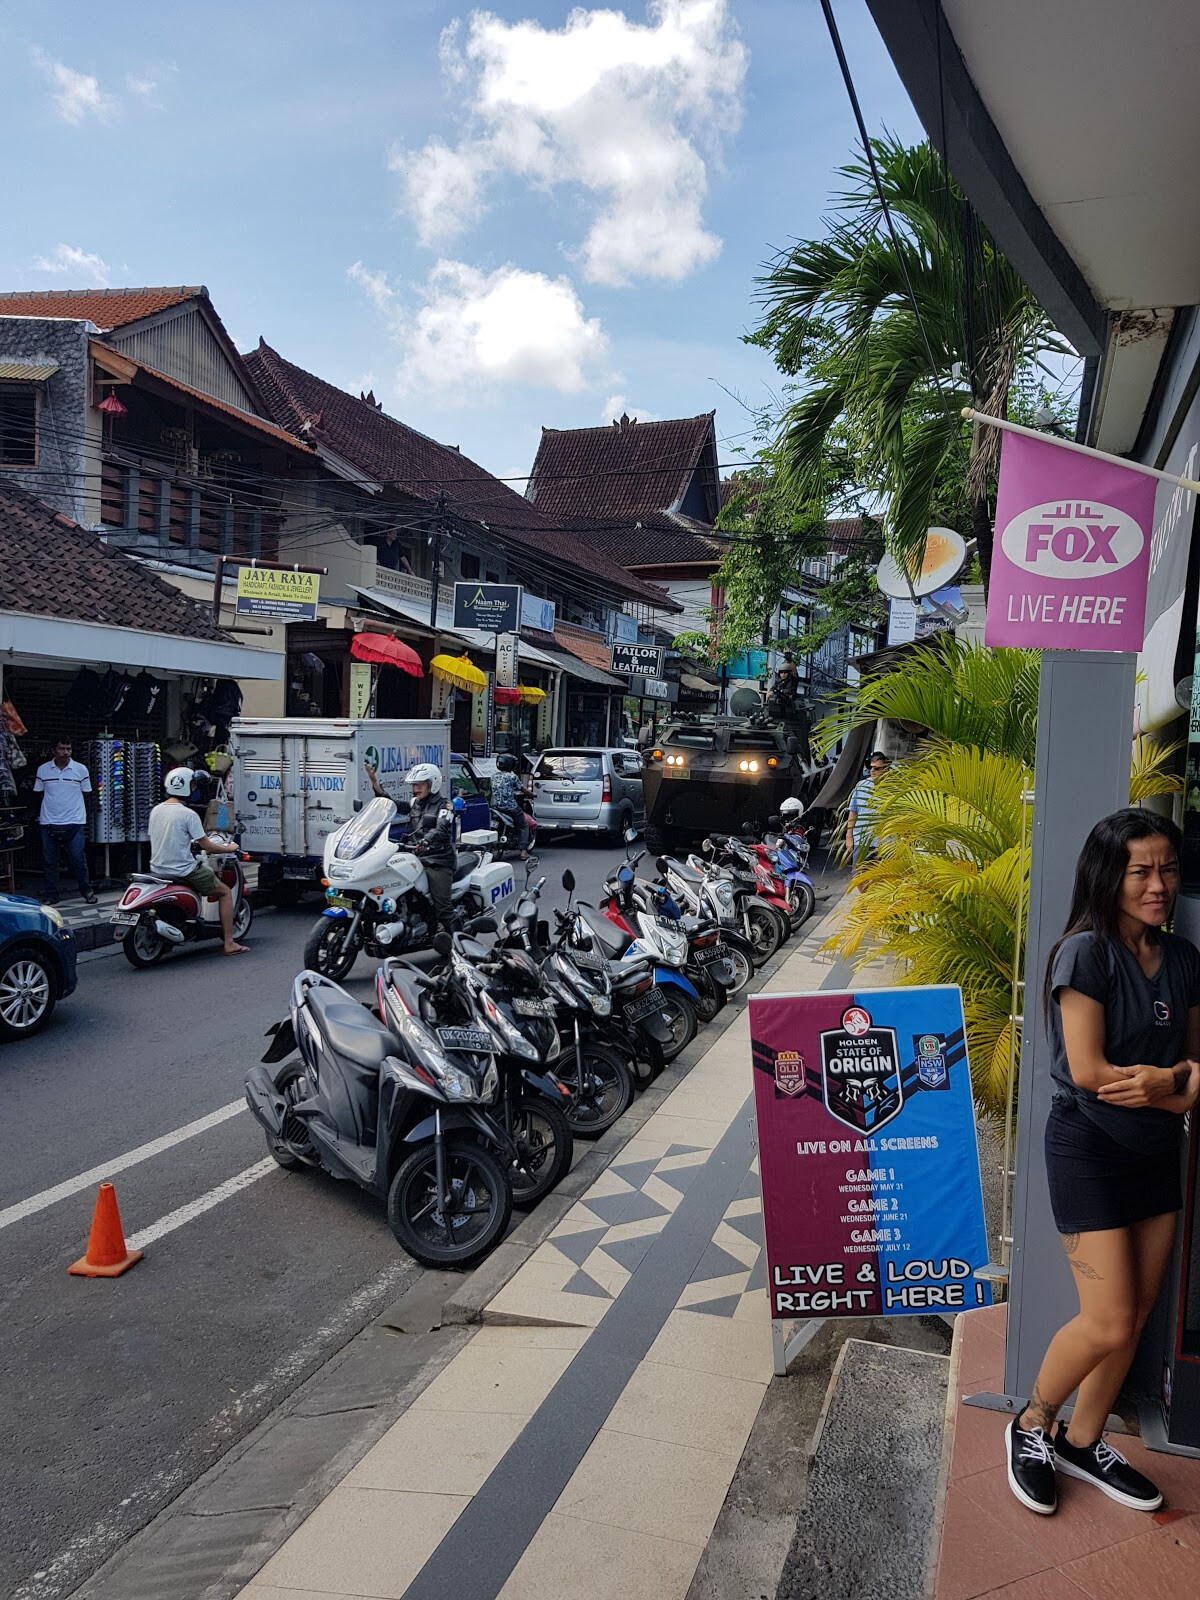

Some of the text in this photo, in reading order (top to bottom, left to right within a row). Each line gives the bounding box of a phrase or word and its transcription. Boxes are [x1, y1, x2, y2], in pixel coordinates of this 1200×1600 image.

[1025, 524, 1120, 564] FOX
[244, 570, 313, 586] JAYA RAYA
[290, 585, 313, 594] JEWELLERY
[1008, 594, 1127, 624] LIVE HERE
[616, 646, 657, 658] TAILOR
[631, 656, 638, 664] &
[613, 662, 656, 675] LEATHER
[381, 747, 402, 773] LISA
[260, 776, 346, 791] LISA LAUNDRY
[491, 878, 513, 903] PM
[836, 1047, 882, 1057] STATE OF
[829, 1056, 892, 1073] ORIGIN
[797, 1136, 939, 1154] LIVE ON ALL SCREENS
[846, 1168, 895, 1182] GAME 1
[839, 1184, 878, 1193] WEDNESDAY
[848, 1198, 898, 1212] GAME 2
[840, 1214, 880, 1222] WEDNESDAY
[851, 1228, 901, 1242] GAME 3
[844, 1245, 884, 1253] WEDNESDAY
[774, 1259, 970, 1286] LIVE & LOUD
[776, 1283, 984, 1312] RIGHT HERE !
